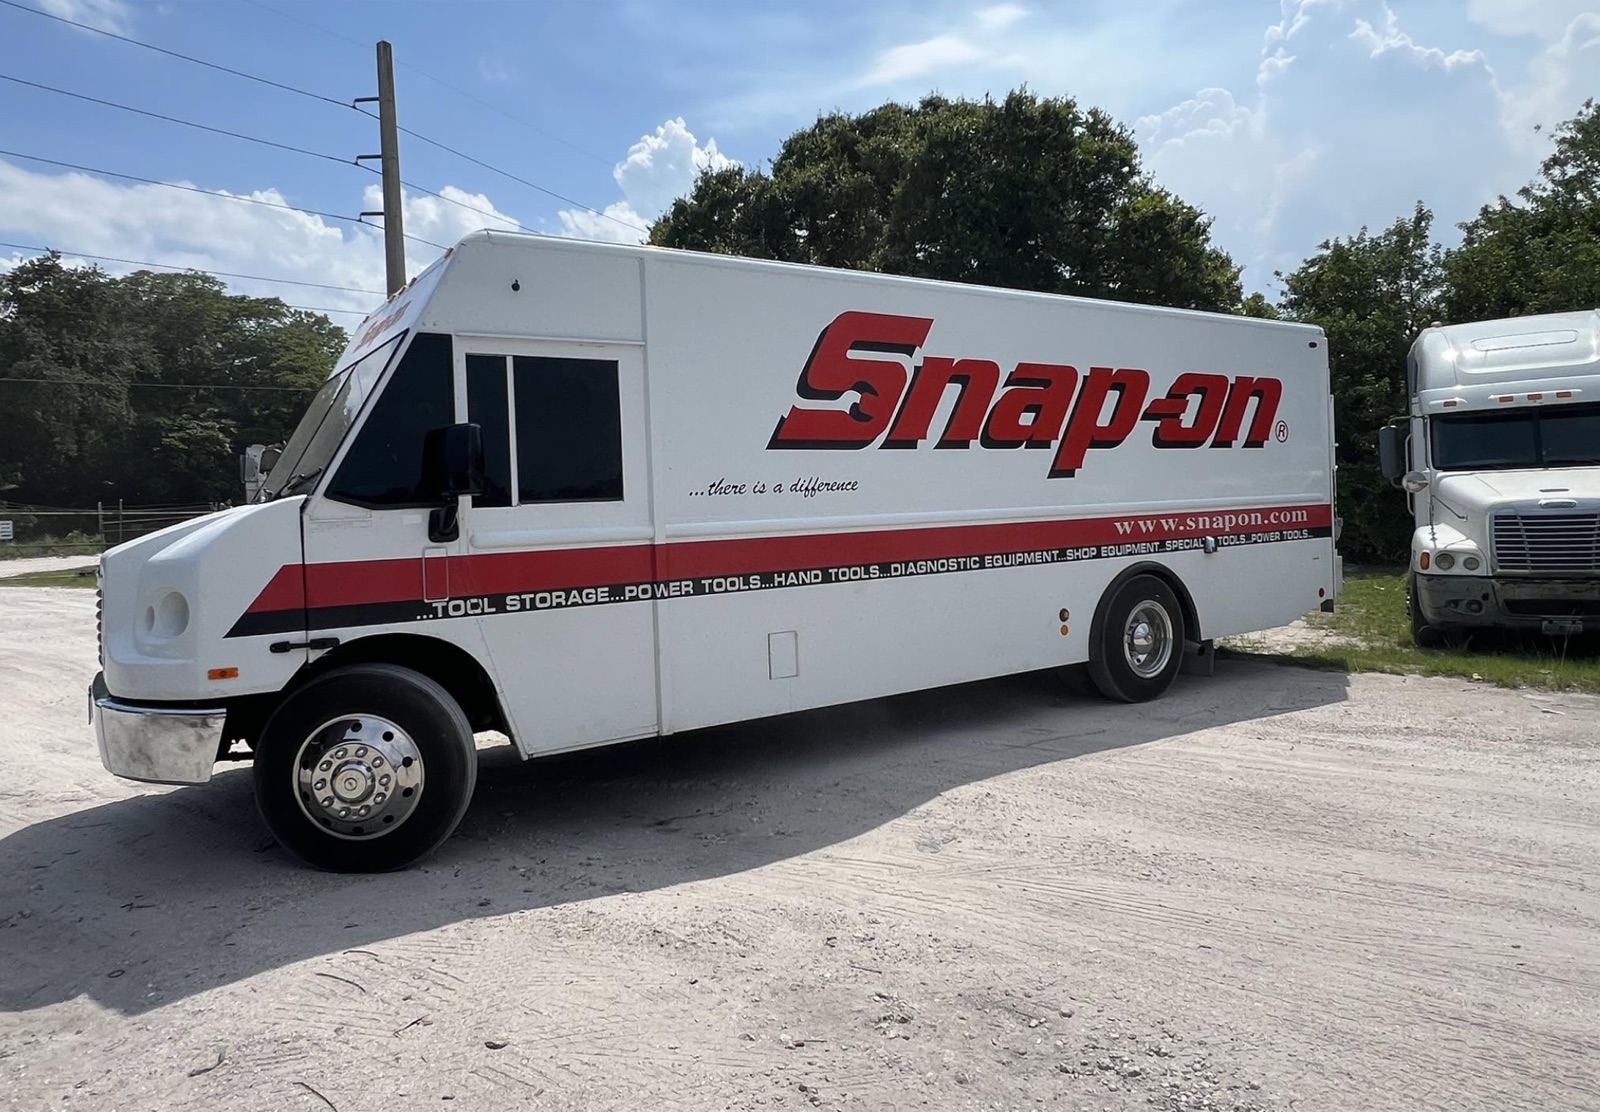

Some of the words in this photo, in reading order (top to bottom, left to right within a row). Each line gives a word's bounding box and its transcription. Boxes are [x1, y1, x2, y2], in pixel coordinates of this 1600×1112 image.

[766, 310, 1282, 478] Snap-on
[752, 480, 767, 495] is
[773, 481, 785, 494] a
[789, 476, 859, 499] difference
[1114, 507, 1309, 537] www.snapon.com
